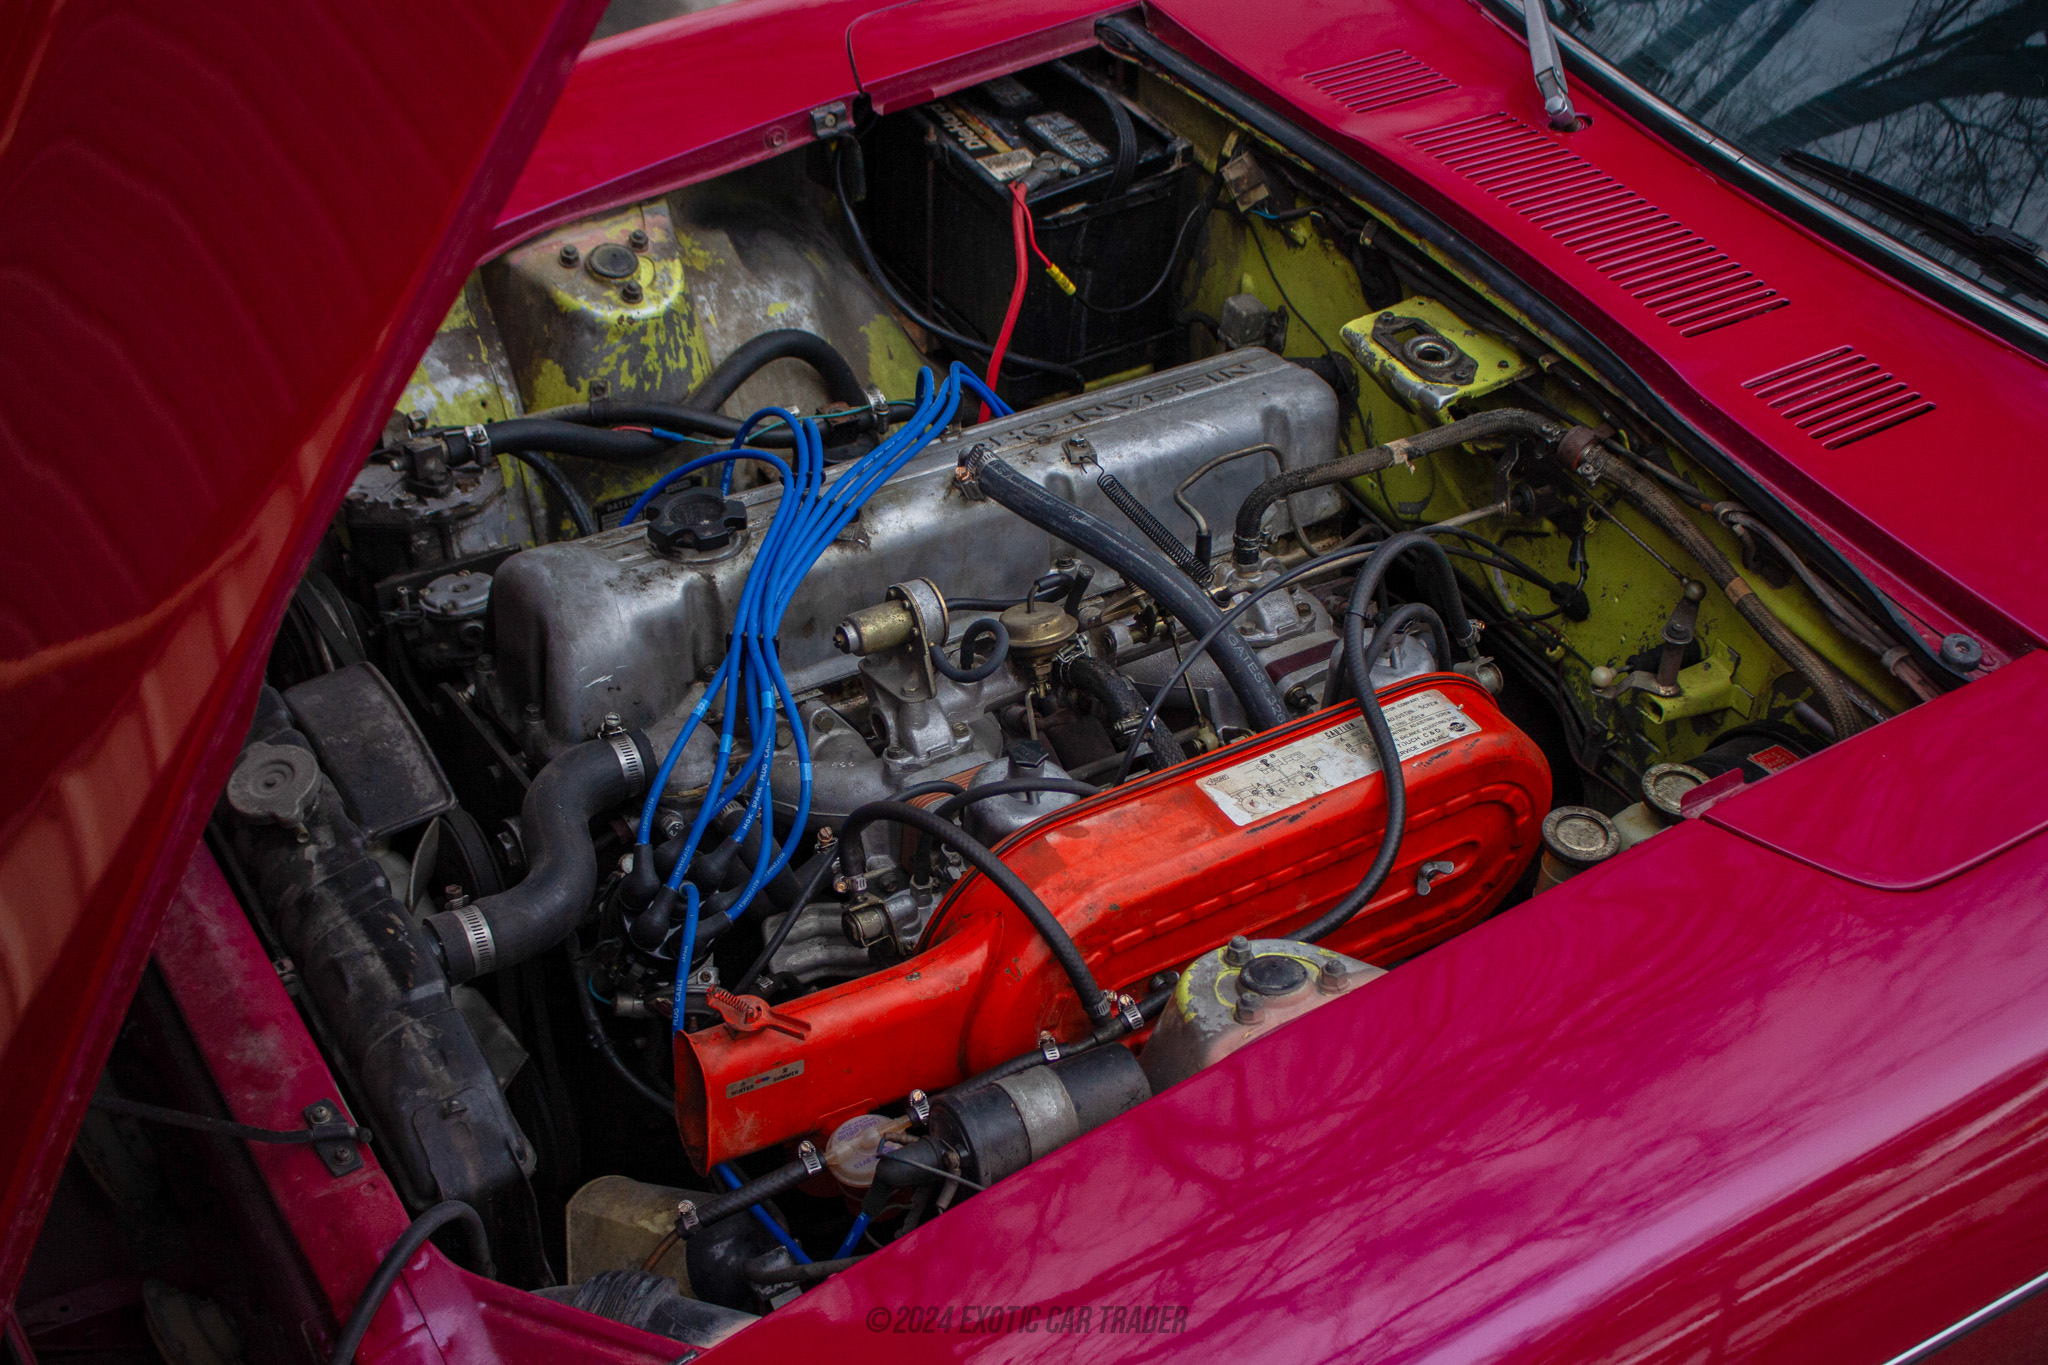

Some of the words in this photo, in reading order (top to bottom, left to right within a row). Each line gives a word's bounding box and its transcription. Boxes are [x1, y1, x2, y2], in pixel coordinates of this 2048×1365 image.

[1072, 364, 1257, 423] NISSAN
[1387, 709, 1416, 722] ADJUSTIN
[1324, 722, 1357, 738] CAUTION
[1396, 737, 1421, 748] TOUCH
[742, 813, 754, 830] NGK
[751, 786, 763, 809] SPARK
[760, 763, 769, 781] PLUG
[675, 979, 684, 1002] CABLE
[672, 1007, 680, 1026] PLUG
[731, 1084, 755, 1096] WINTER
[773, 1070, 799, 1083] SUMMER
